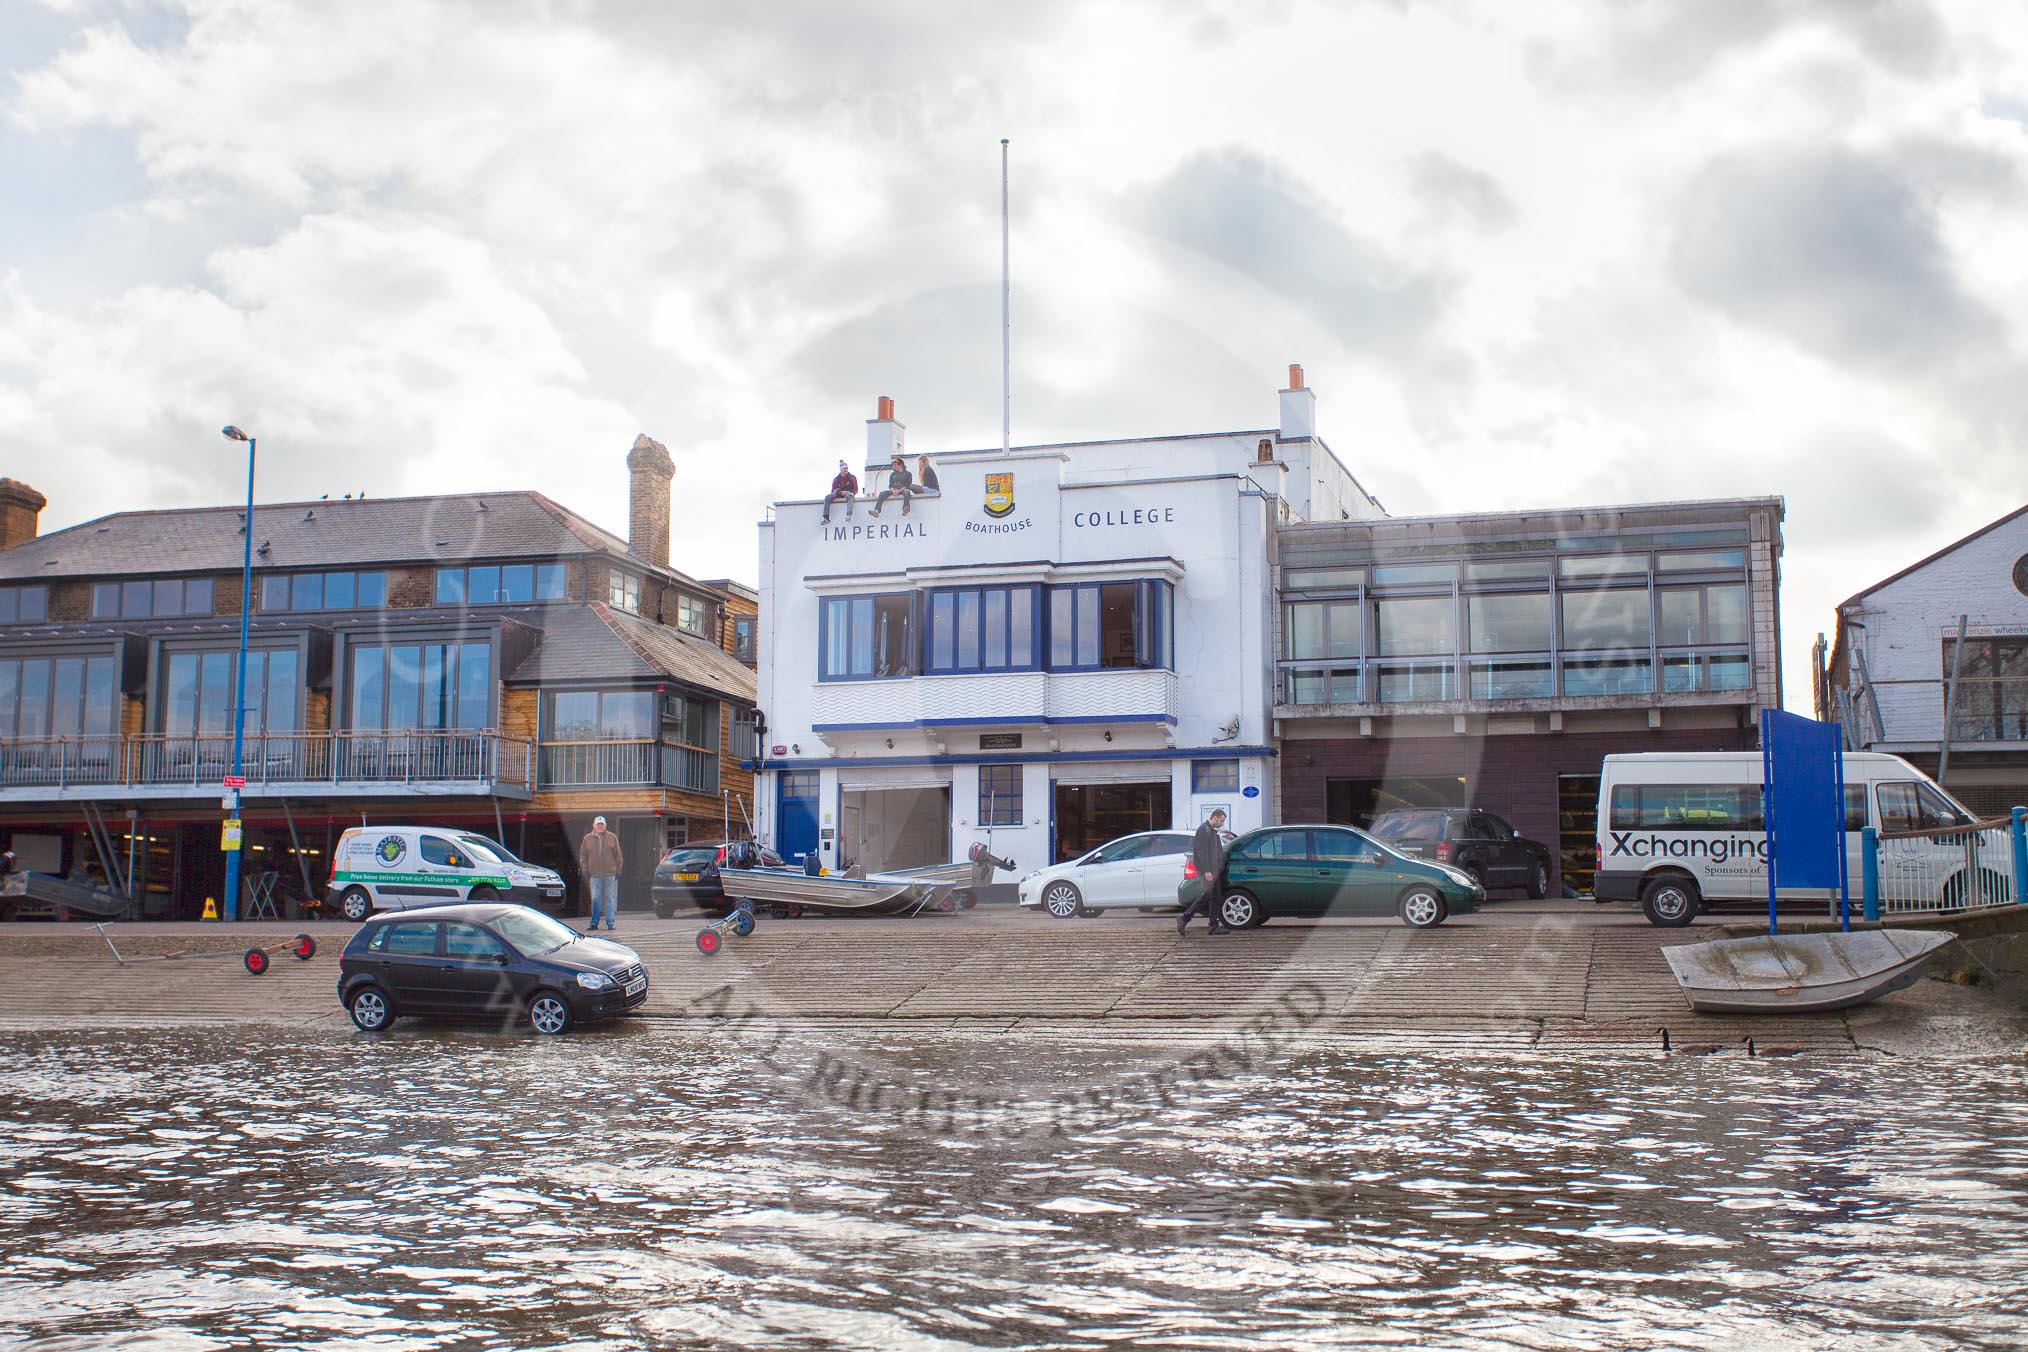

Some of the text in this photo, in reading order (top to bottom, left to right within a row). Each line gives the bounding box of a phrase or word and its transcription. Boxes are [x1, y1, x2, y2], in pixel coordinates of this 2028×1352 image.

[824, 507, 1174, 541] IMPERIAL COLLEGE
[965, 518, 1033, 534] BOATHOUSE
[1944, 627, 1992, 636] maenzie
[376, 836, 405, 854] MAJESTIC
[1704, 865, 1748, 876] Sponsors
[1750, 865, 1761, 874] of
[378, 874, 400, 882] delivery
